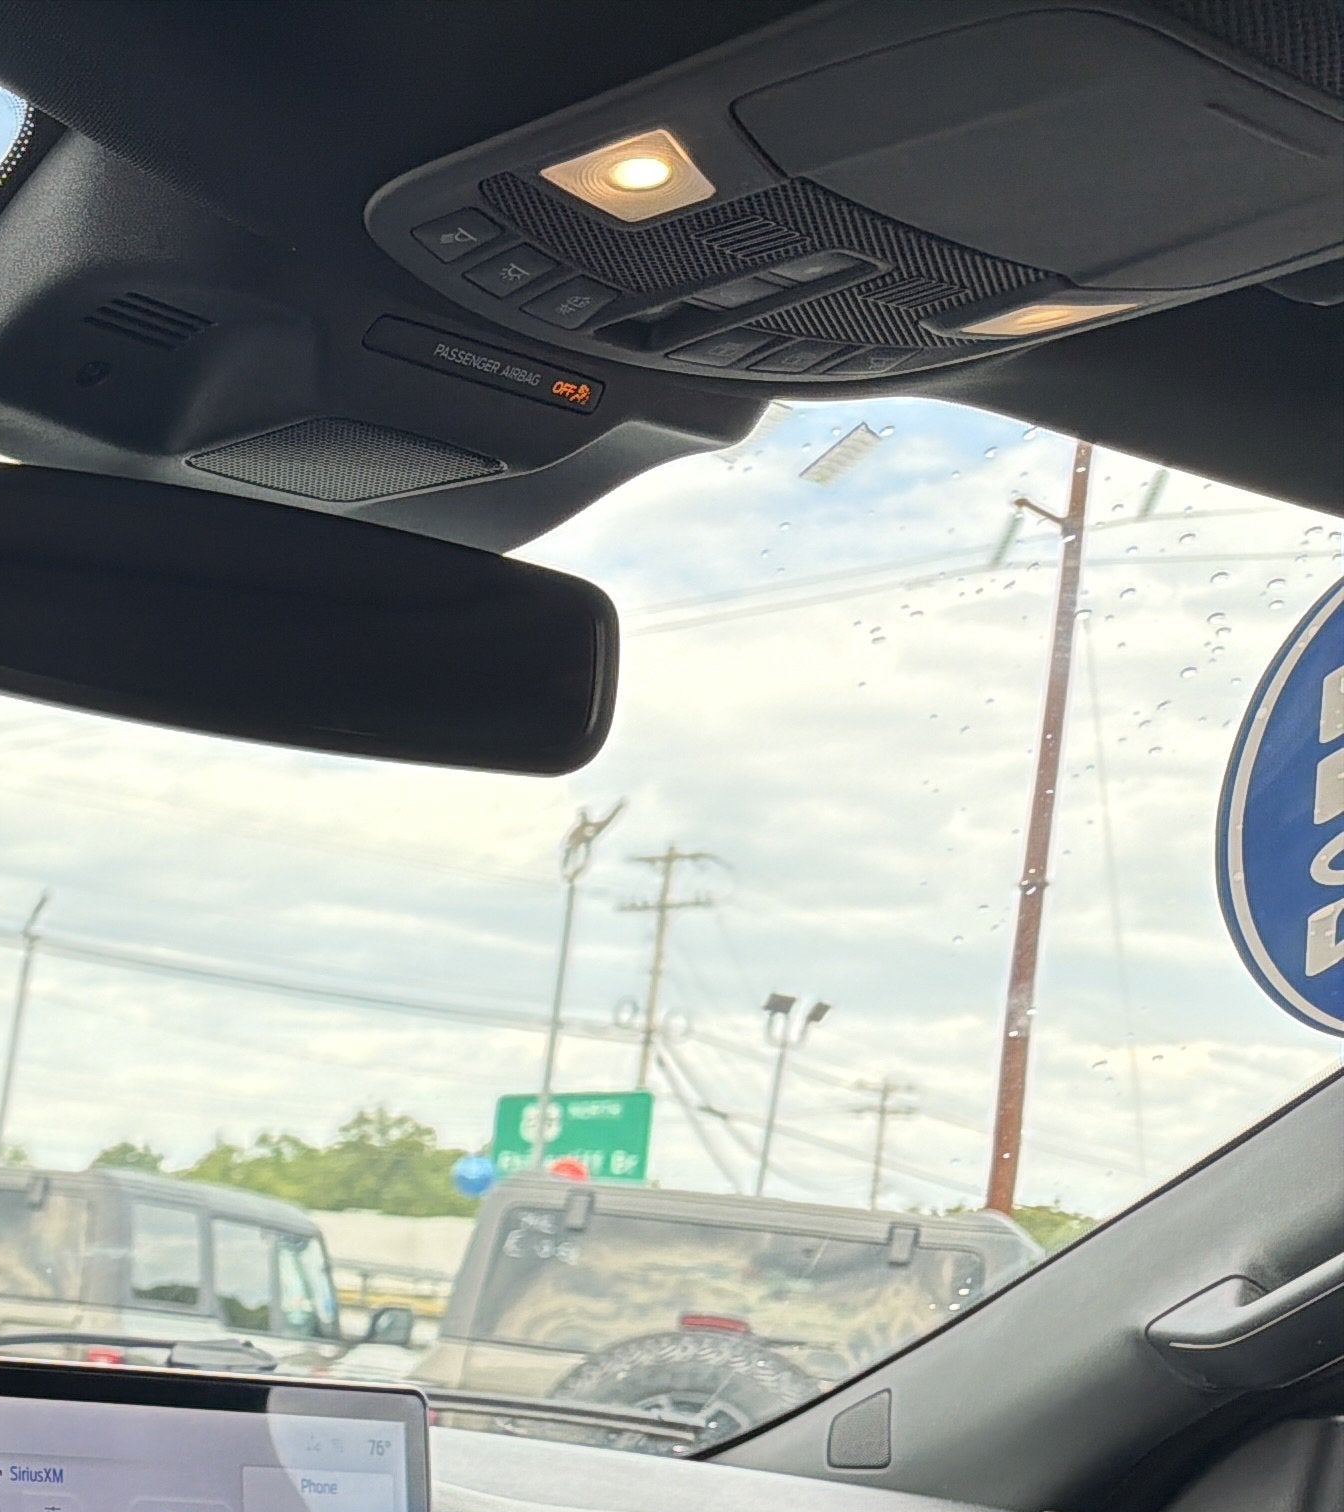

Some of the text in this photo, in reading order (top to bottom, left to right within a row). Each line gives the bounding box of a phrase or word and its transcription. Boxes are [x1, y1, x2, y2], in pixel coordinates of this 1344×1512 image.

[433, 343, 577, 398] PASSENGER AIRBAG OFF
[368, 1439, 392, 1456] 76°
[10, 1465, 64, 1484] SiriusXM
[301, 1478, 338, 1495] Phone
